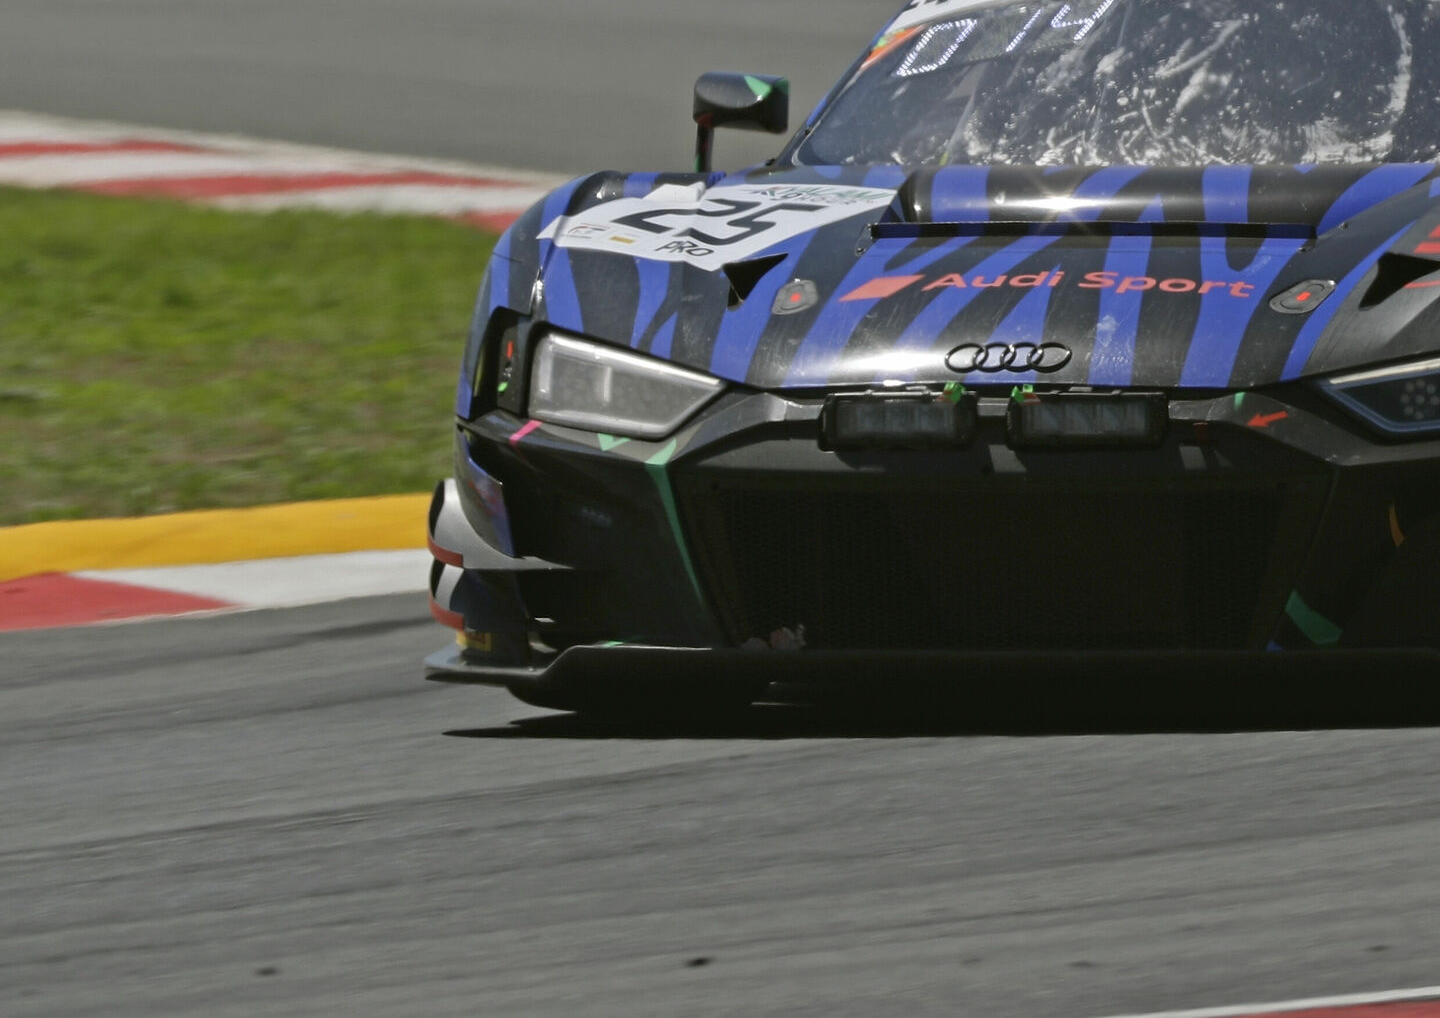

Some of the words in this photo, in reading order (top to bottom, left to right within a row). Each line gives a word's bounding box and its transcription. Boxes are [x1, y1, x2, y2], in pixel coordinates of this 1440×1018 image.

[611, 198, 830, 246] 25
[654, 240, 716, 258] PRO
[921, 270, 1066, 292] Audi
[1077, 270, 1256, 299] Sport
